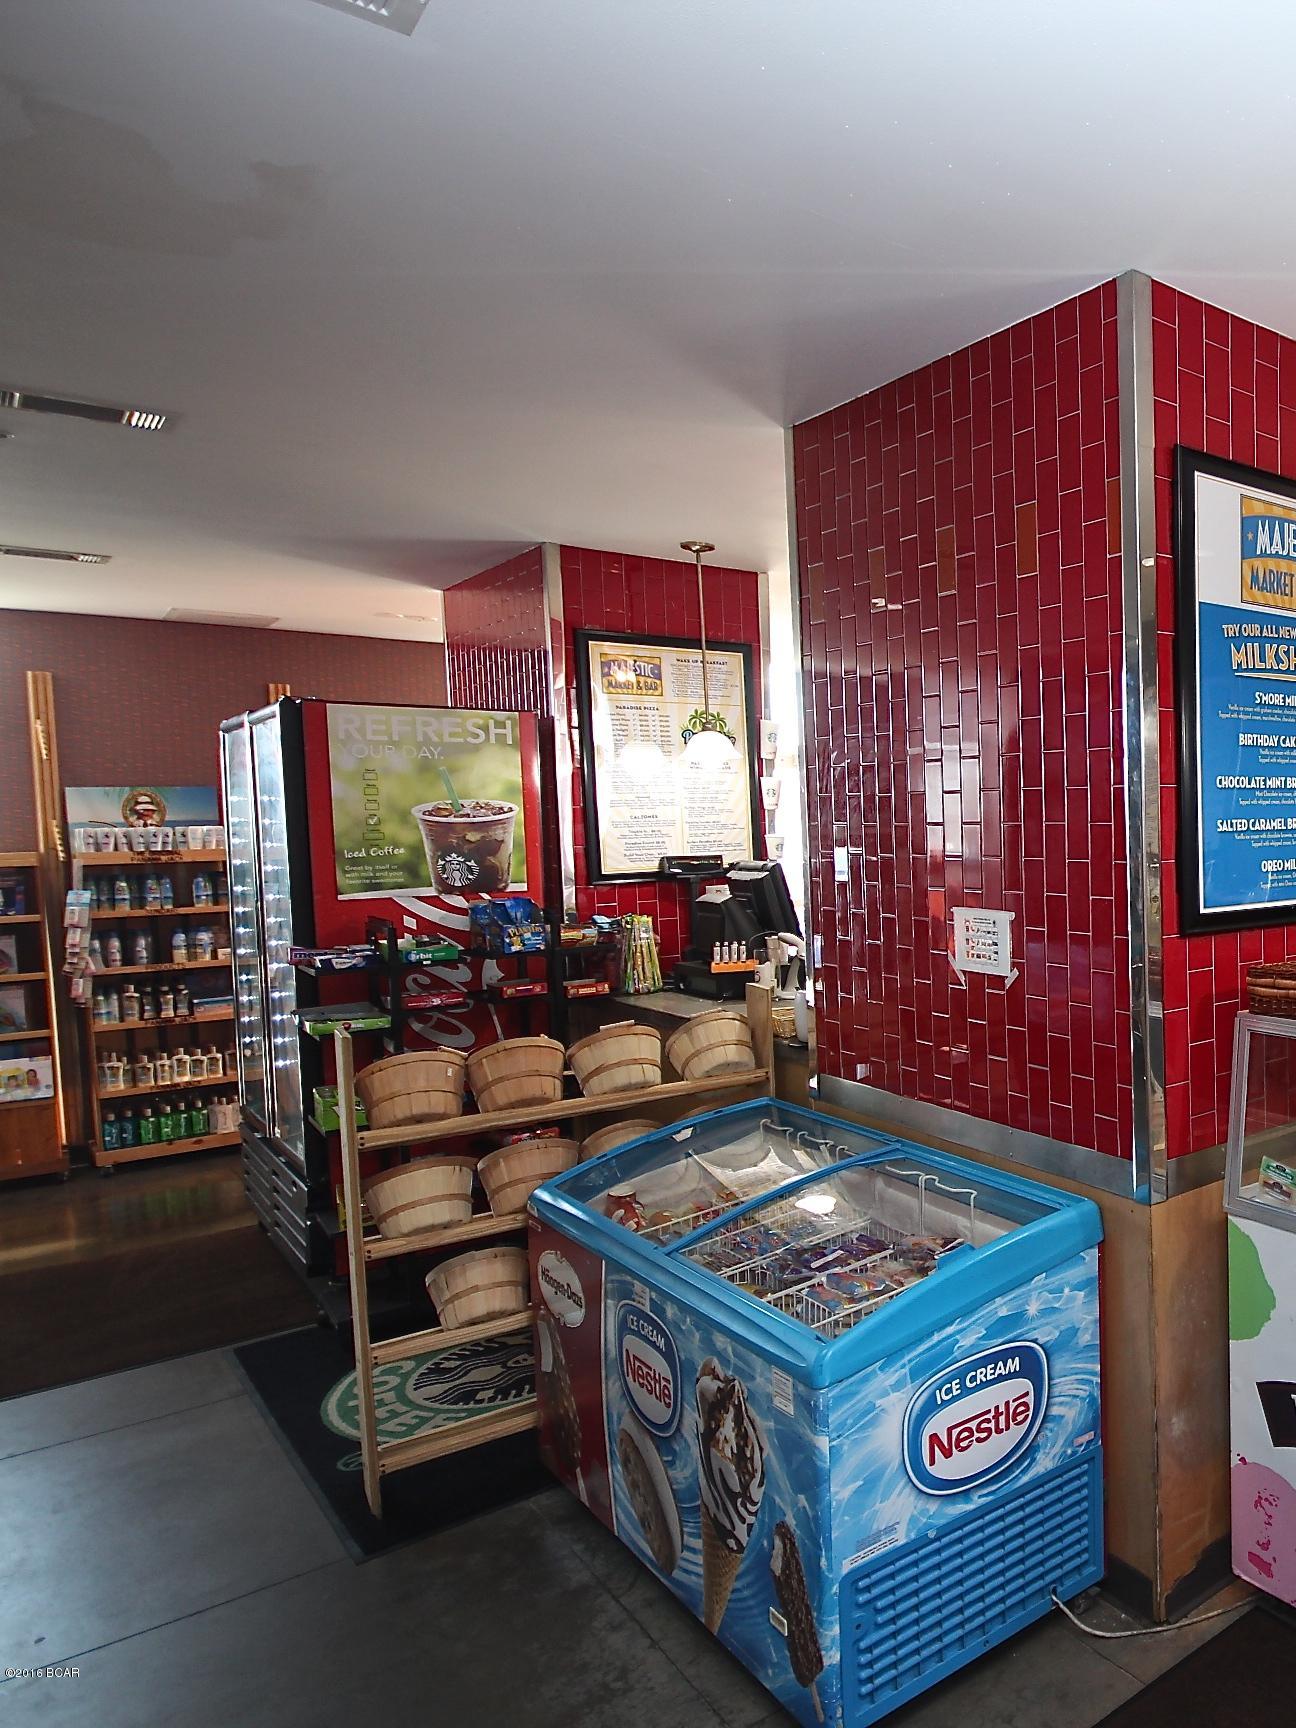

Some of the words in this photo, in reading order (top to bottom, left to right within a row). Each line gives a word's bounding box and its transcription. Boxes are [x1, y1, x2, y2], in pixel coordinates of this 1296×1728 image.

[1250, 565, 1294, 597] MARKET
[1222, 624, 1240, 638] TRY
[1242, 624, 1261, 637] OUR
[1262, 625, 1278, 638] ALL
[1279, 626, 1296, 640] NEW
[636, 681, 642, 690] &
[645, 680, 658, 690] BAR
[1255, 692, 1284, 706] S'MORE
[337, 714, 513, 745] REFRESH
[1239, 734, 1279, 747] BIRTHDAY
[1216, 776, 1265, 788] CHOCOLATE
[1267, 777, 1285, 788] MINT
[1217, 819, 1248, 832] SALTED
[1250, 818, 1286, 830] CARAMEL
[344, 849, 367, 859] Iced
[370, 846, 406, 857] Coffee
[1261, 860, 1283, 872] OREO
[627, 1313, 637, 1330] ICE
[639, 1320, 665, 1352] CREAM
[935, 1378, 961, 1405] ICE
[965, 1356, 1020, 1389] CREAM
